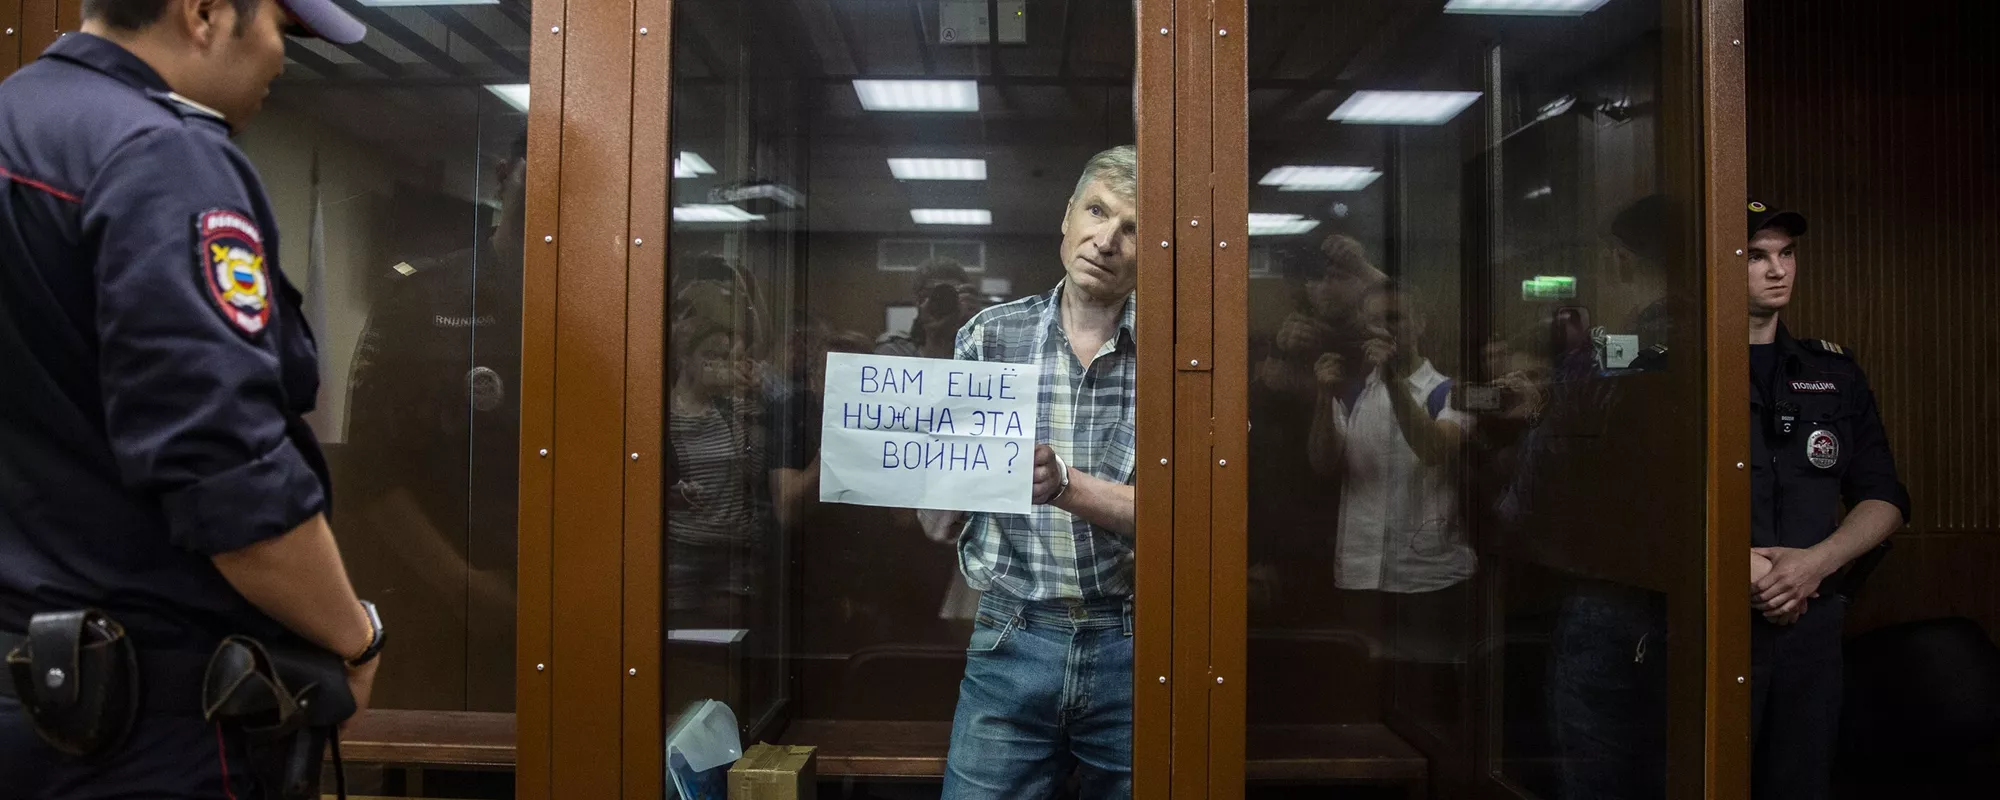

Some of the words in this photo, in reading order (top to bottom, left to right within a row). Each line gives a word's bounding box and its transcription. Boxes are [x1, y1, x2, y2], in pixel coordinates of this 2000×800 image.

[860, 365, 923, 395] ВАМ
[947, 367, 1018, 401] ЕЩЁ
[1791, 382, 1836, 391] ПОЛИЦИЯ
[843, 402, 955, 434] НУЖНА
[969, 410, 1023, 437] ЭТА
[882, 438, 989, 471] ВОЙНА
[1004, 441, 1020, 474] ?
